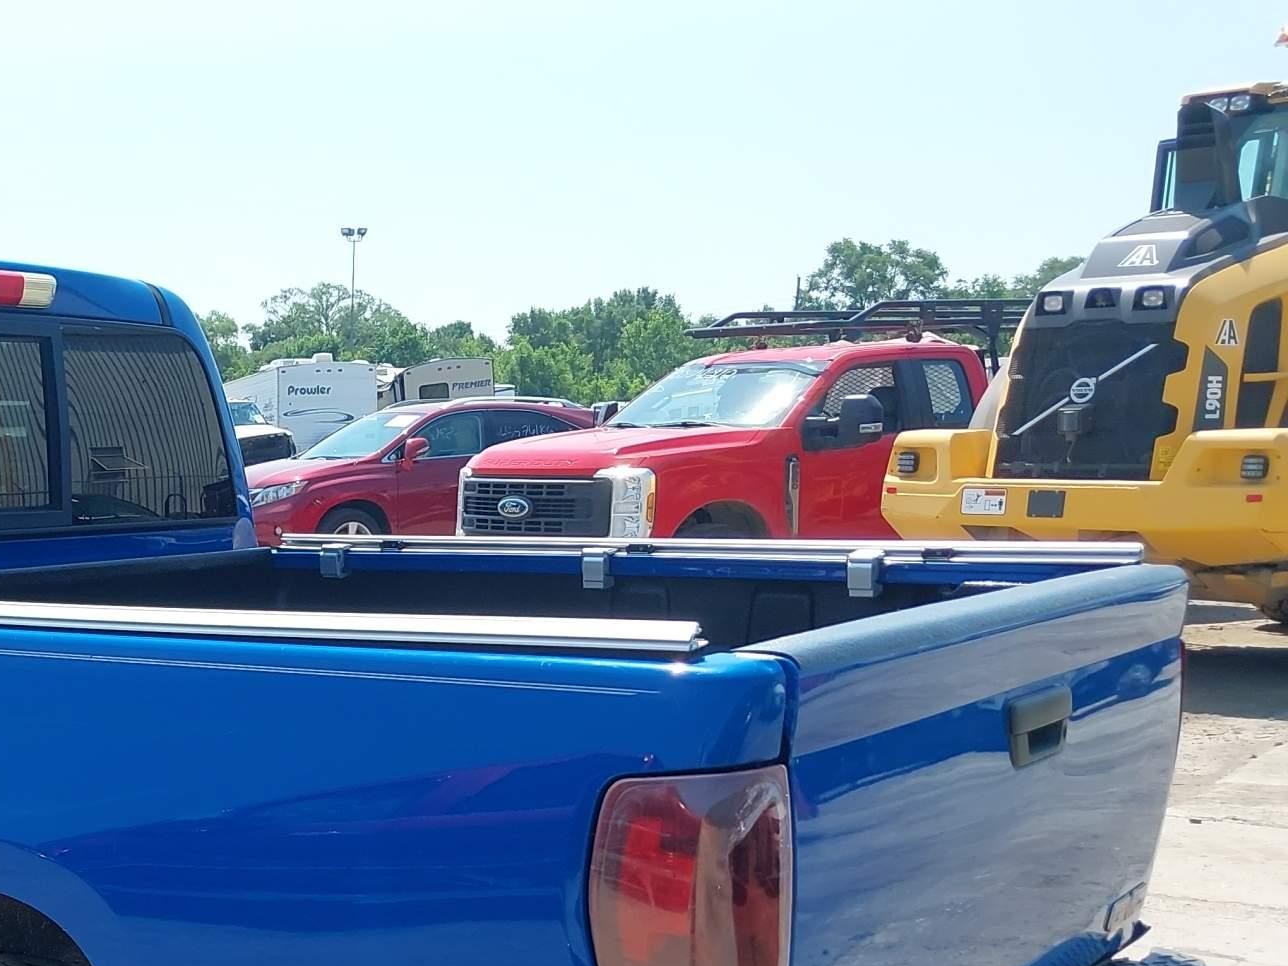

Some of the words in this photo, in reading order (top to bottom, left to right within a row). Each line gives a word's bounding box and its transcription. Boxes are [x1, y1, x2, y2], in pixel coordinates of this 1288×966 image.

[287, 384, 332, 396] Prowler
[452, 379, 491, 391] PREMIER
[1204, 375, 1223, 419] L90H
